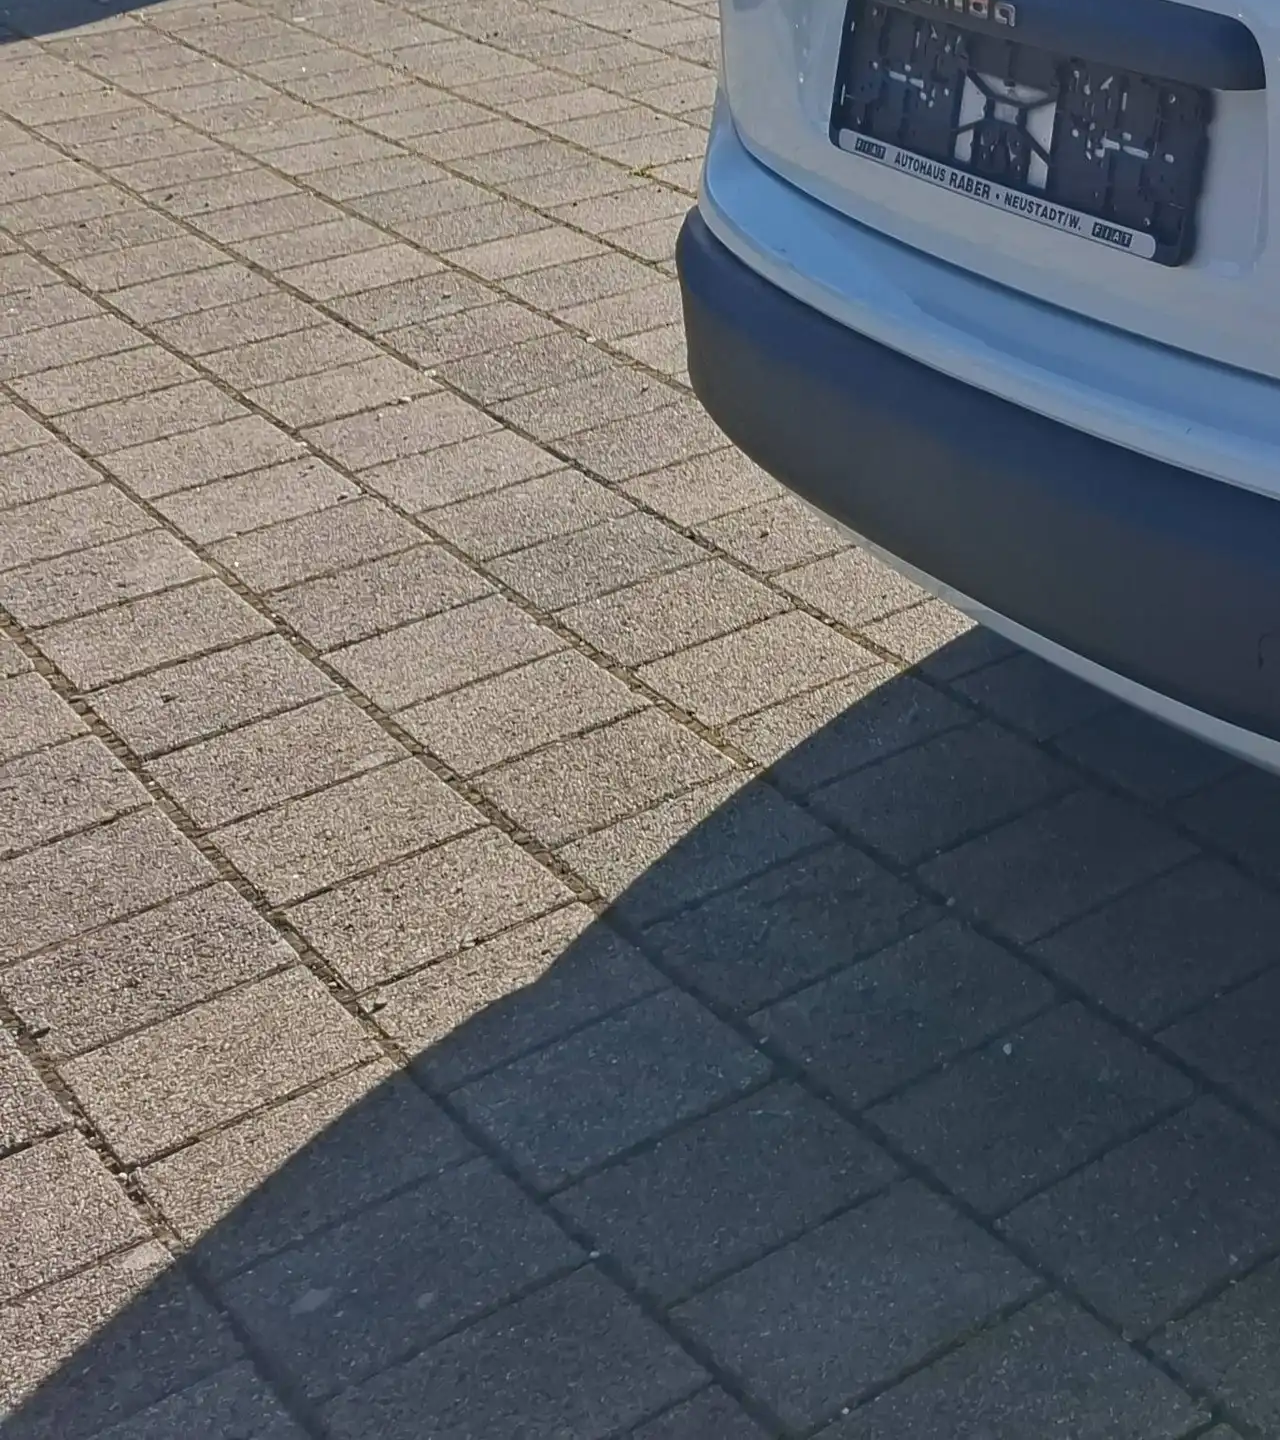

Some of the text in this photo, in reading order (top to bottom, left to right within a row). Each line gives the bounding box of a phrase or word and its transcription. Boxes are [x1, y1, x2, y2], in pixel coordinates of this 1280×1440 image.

[894, 151, 947, 182] AUTOHAUS
[948, 171, 991, 200] RABER
[1003, 191, 1082, 232] NEUSTADT/W.
[1092, 221, 1134, 249] FIAT
